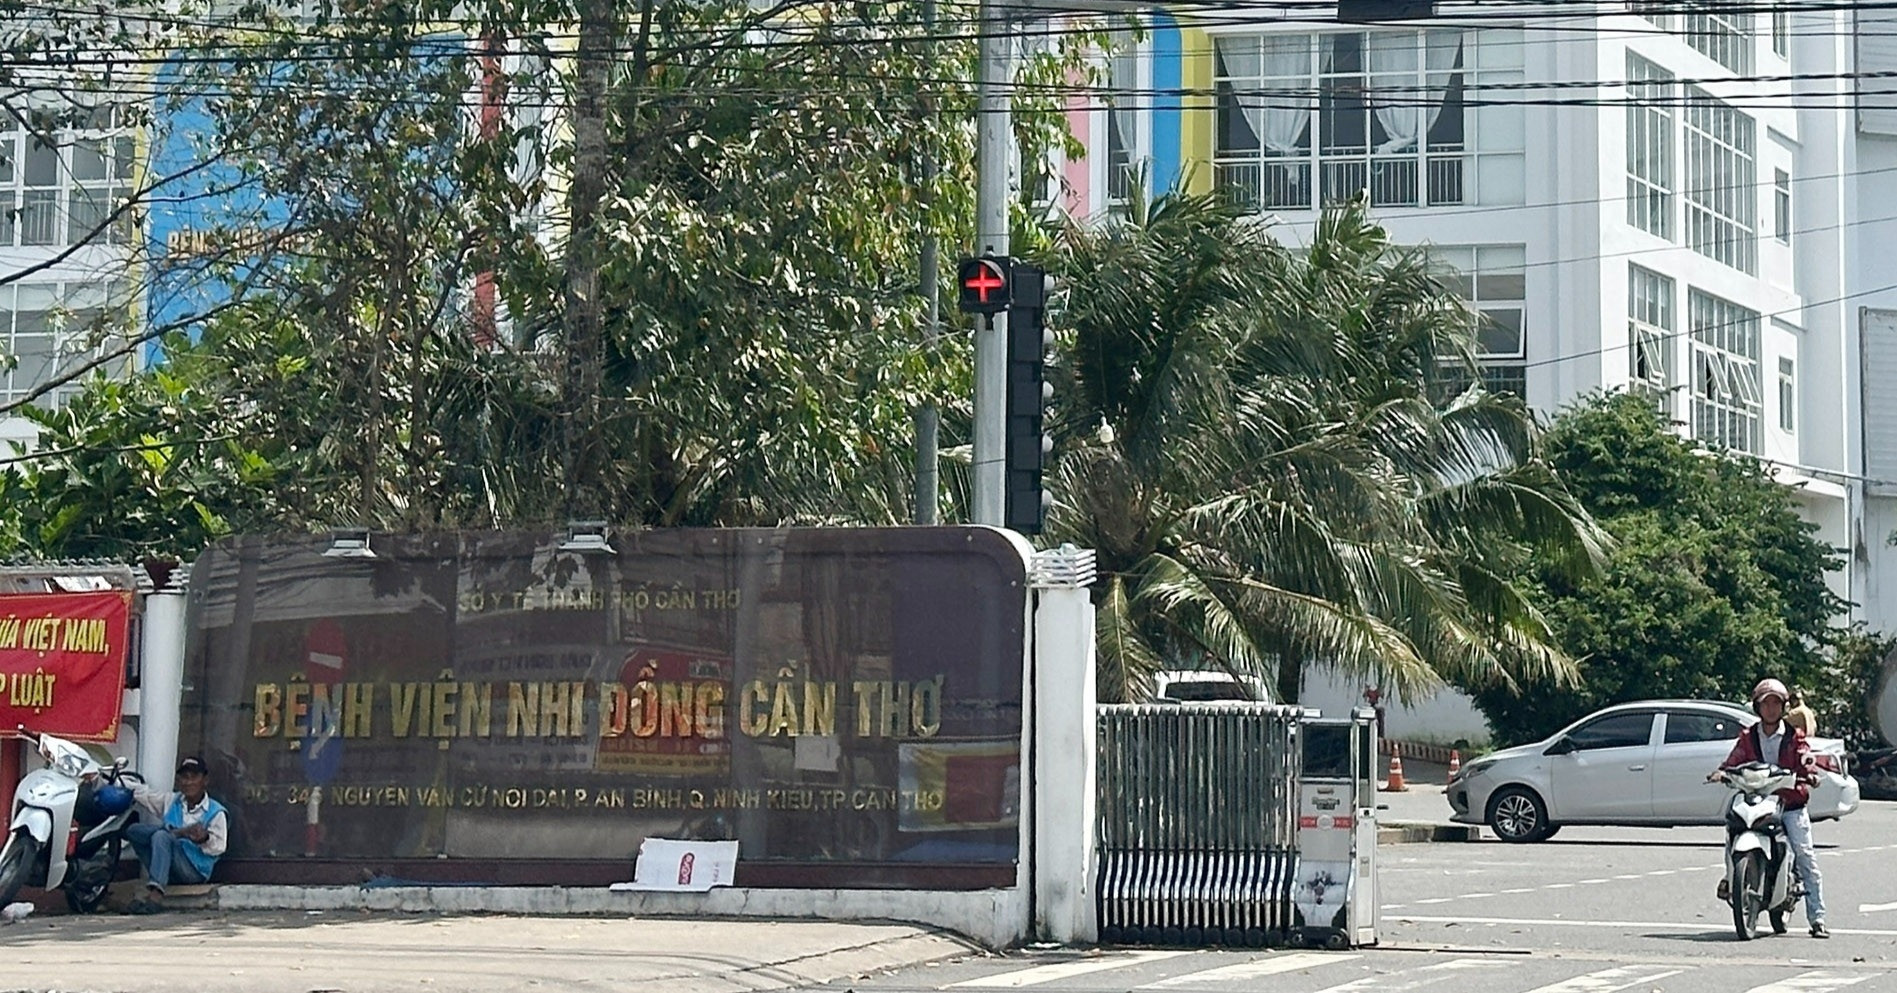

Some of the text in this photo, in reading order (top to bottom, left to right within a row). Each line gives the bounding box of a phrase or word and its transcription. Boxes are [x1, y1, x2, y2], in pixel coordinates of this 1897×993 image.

[22, 612, 61, 658] VIỆT
[61, 618, 110, 657] NAM,
[10, 666, 56, 714] LUẬT
[254, 658, 945, 750] BỆNH VIỆN NHI ĐỒNG CẦN THƠ
[593, 788, 626, 808] AN
